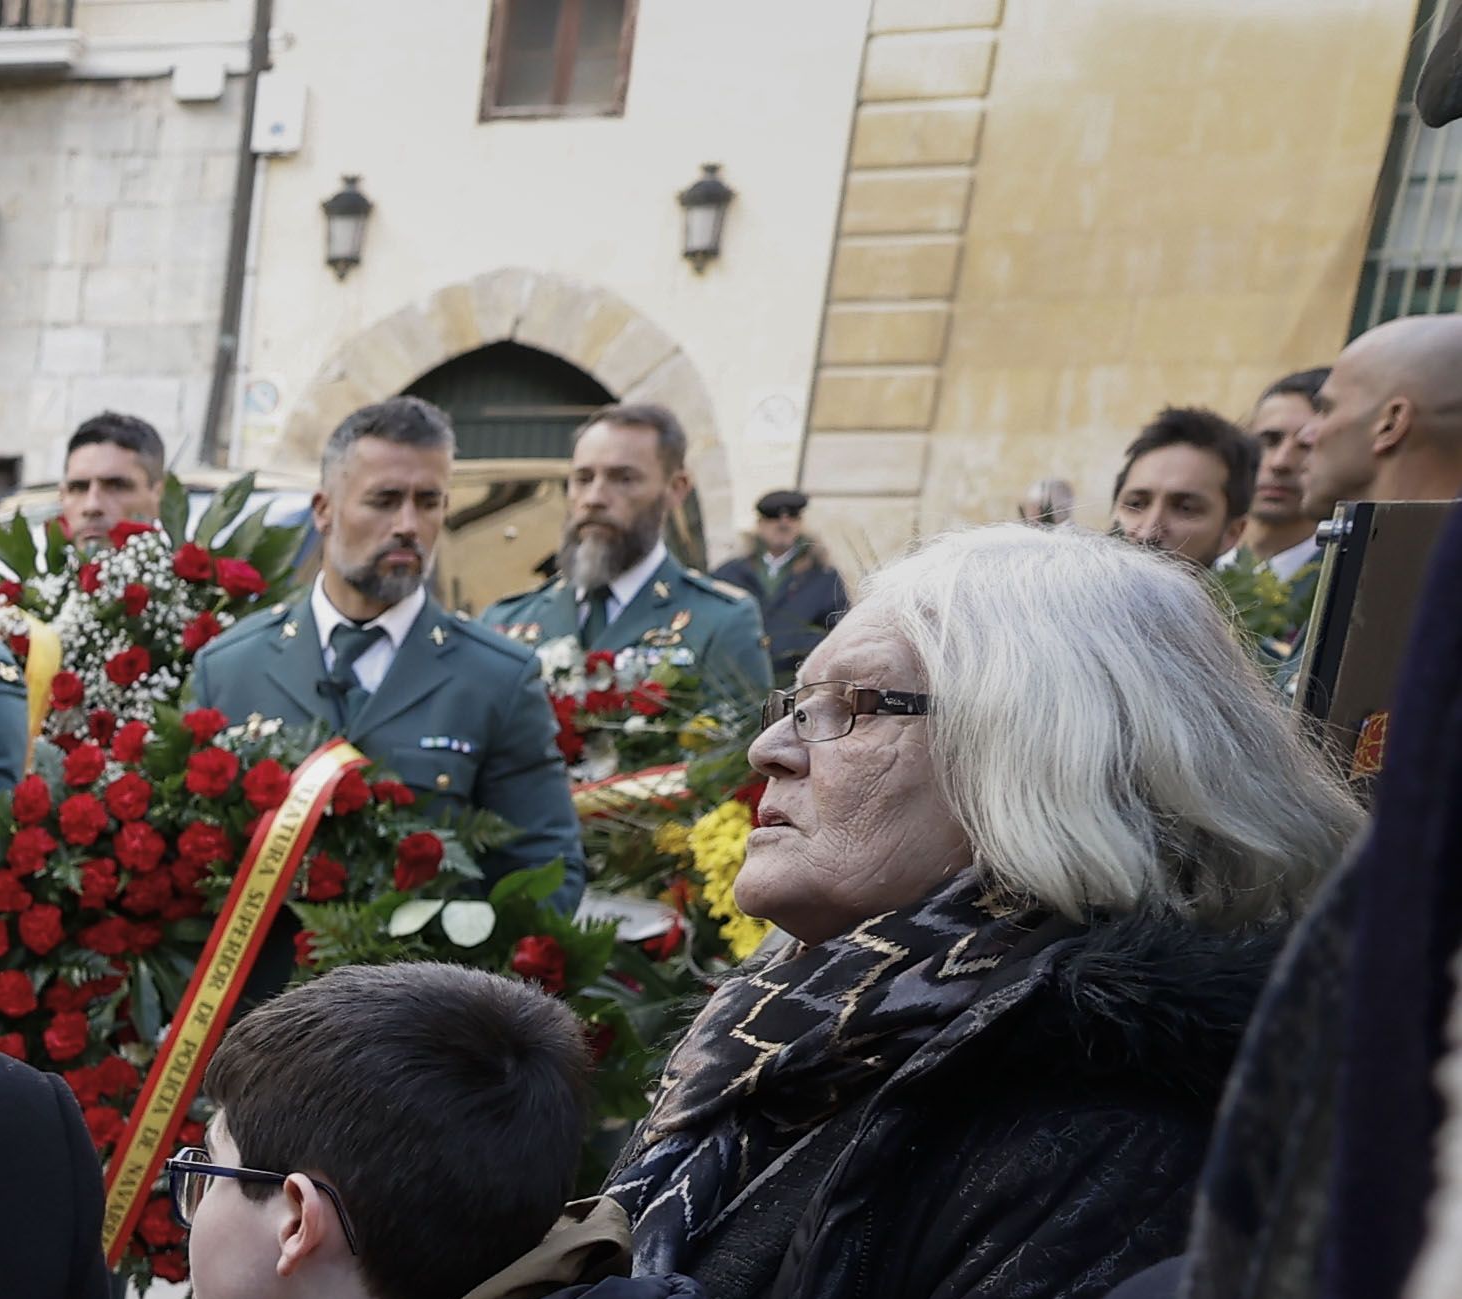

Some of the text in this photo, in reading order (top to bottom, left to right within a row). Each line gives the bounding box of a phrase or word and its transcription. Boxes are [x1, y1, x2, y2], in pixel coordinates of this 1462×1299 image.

[209, 888, 264, 990] SUPERIOR
[193, 1001, 213, 1026] DE
[152, 1039, 198, 1115] POLICIA
[137, 1127, 160, 1149] DE
